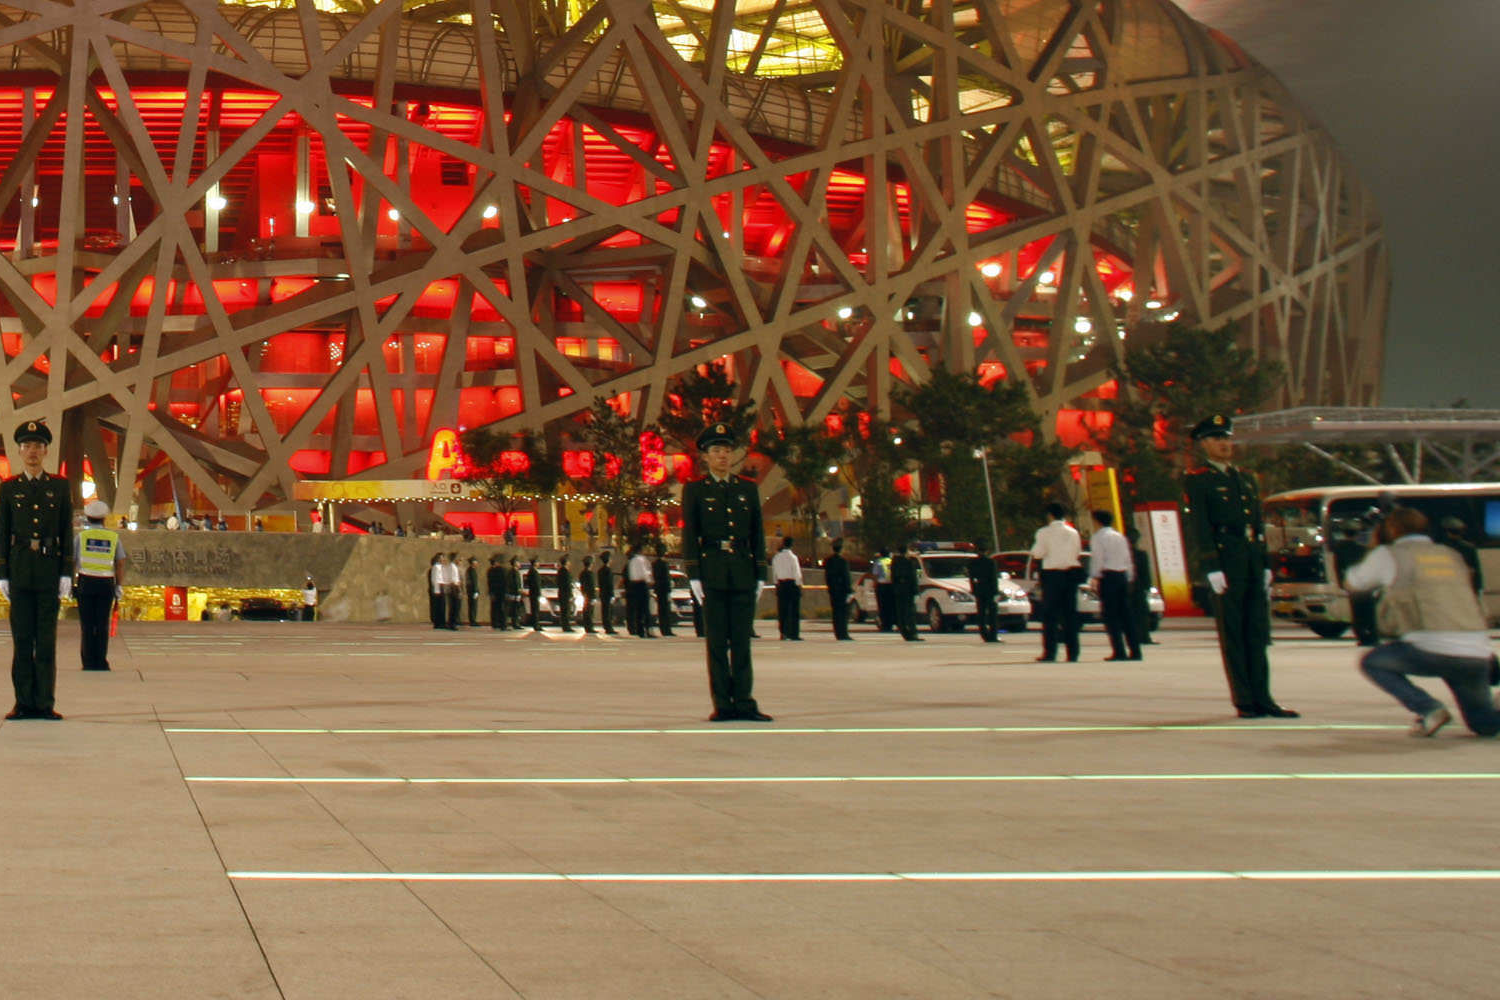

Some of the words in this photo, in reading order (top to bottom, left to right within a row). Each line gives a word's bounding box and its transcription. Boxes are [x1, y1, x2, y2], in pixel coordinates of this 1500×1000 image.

[426, 428, 469, 482] A
[131, 546, 231, 564] 国家体育场
